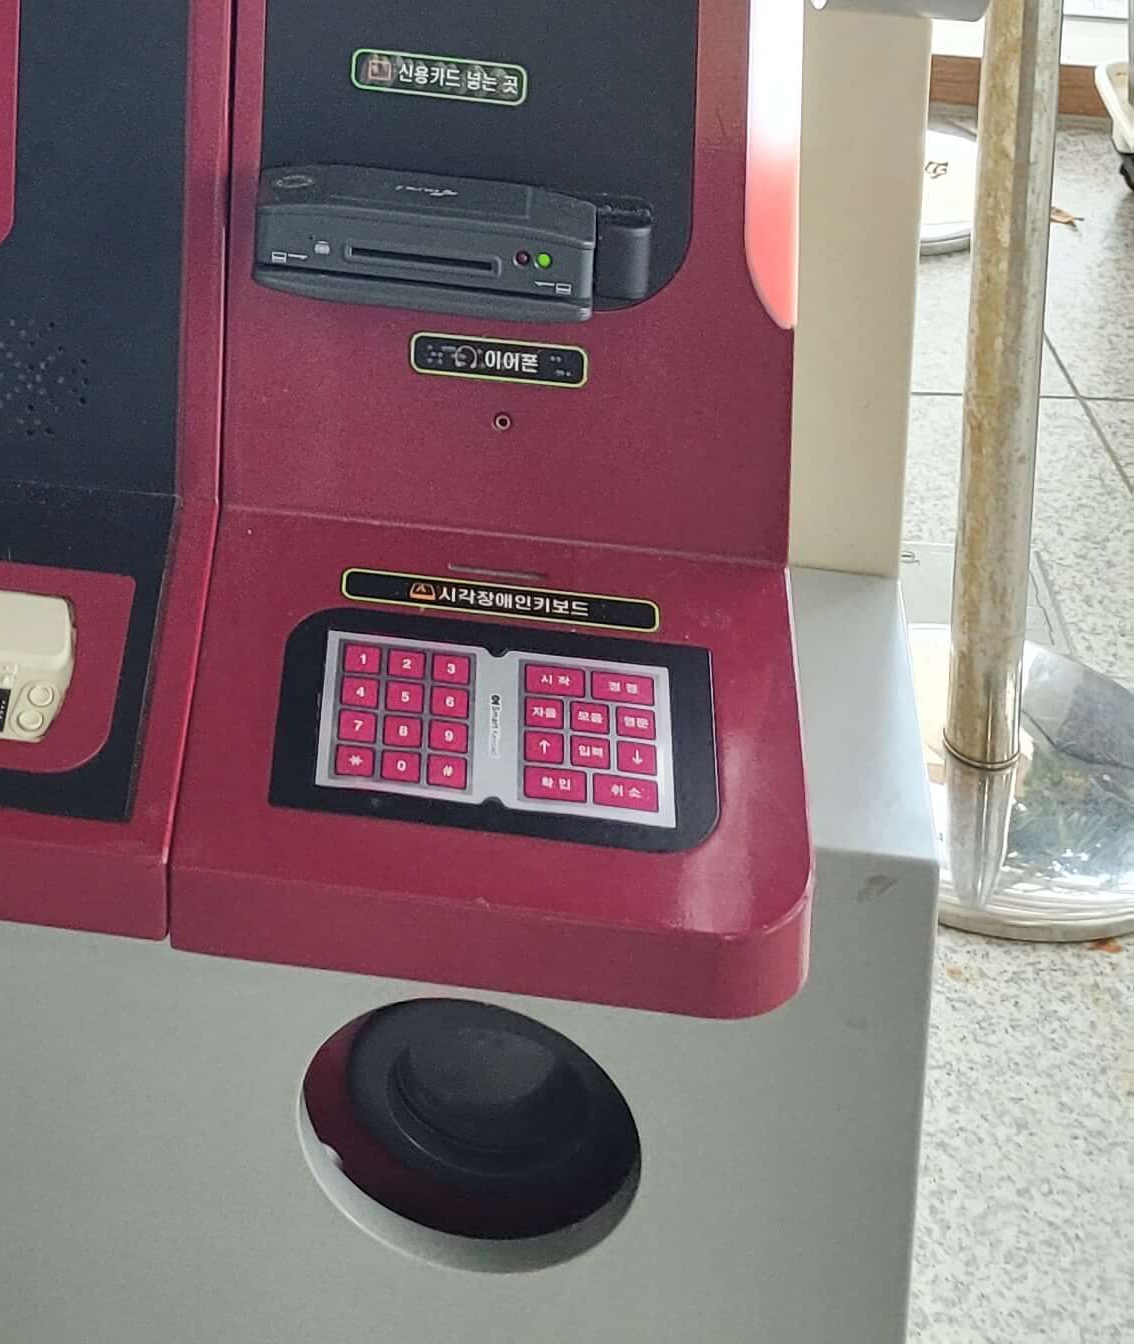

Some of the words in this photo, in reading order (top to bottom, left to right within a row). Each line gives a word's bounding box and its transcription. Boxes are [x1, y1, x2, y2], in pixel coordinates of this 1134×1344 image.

[398, 64, 460, 87] 신용카드
[466, 70, 497, 93] 넣는
[502, 75, 518, 95] 곳
[485, 350, 538, 373] 이어폰
[438, 583, 589, 618] 시각장애인키보드
[359, 653, 367, 665] 1
[402, 658, 412, 670] 2
[447, 663, 456, 674] 3
[355, 686, 365, 697] 4
[401, 691, 410, 703] 5
[445, 696, 455, 708] 6
[354, 720, 363, 732] 7
[398, 725, 408, 737] 8
[444, 730, 454, 742] 9
[397, 760, 407, 772] 0
